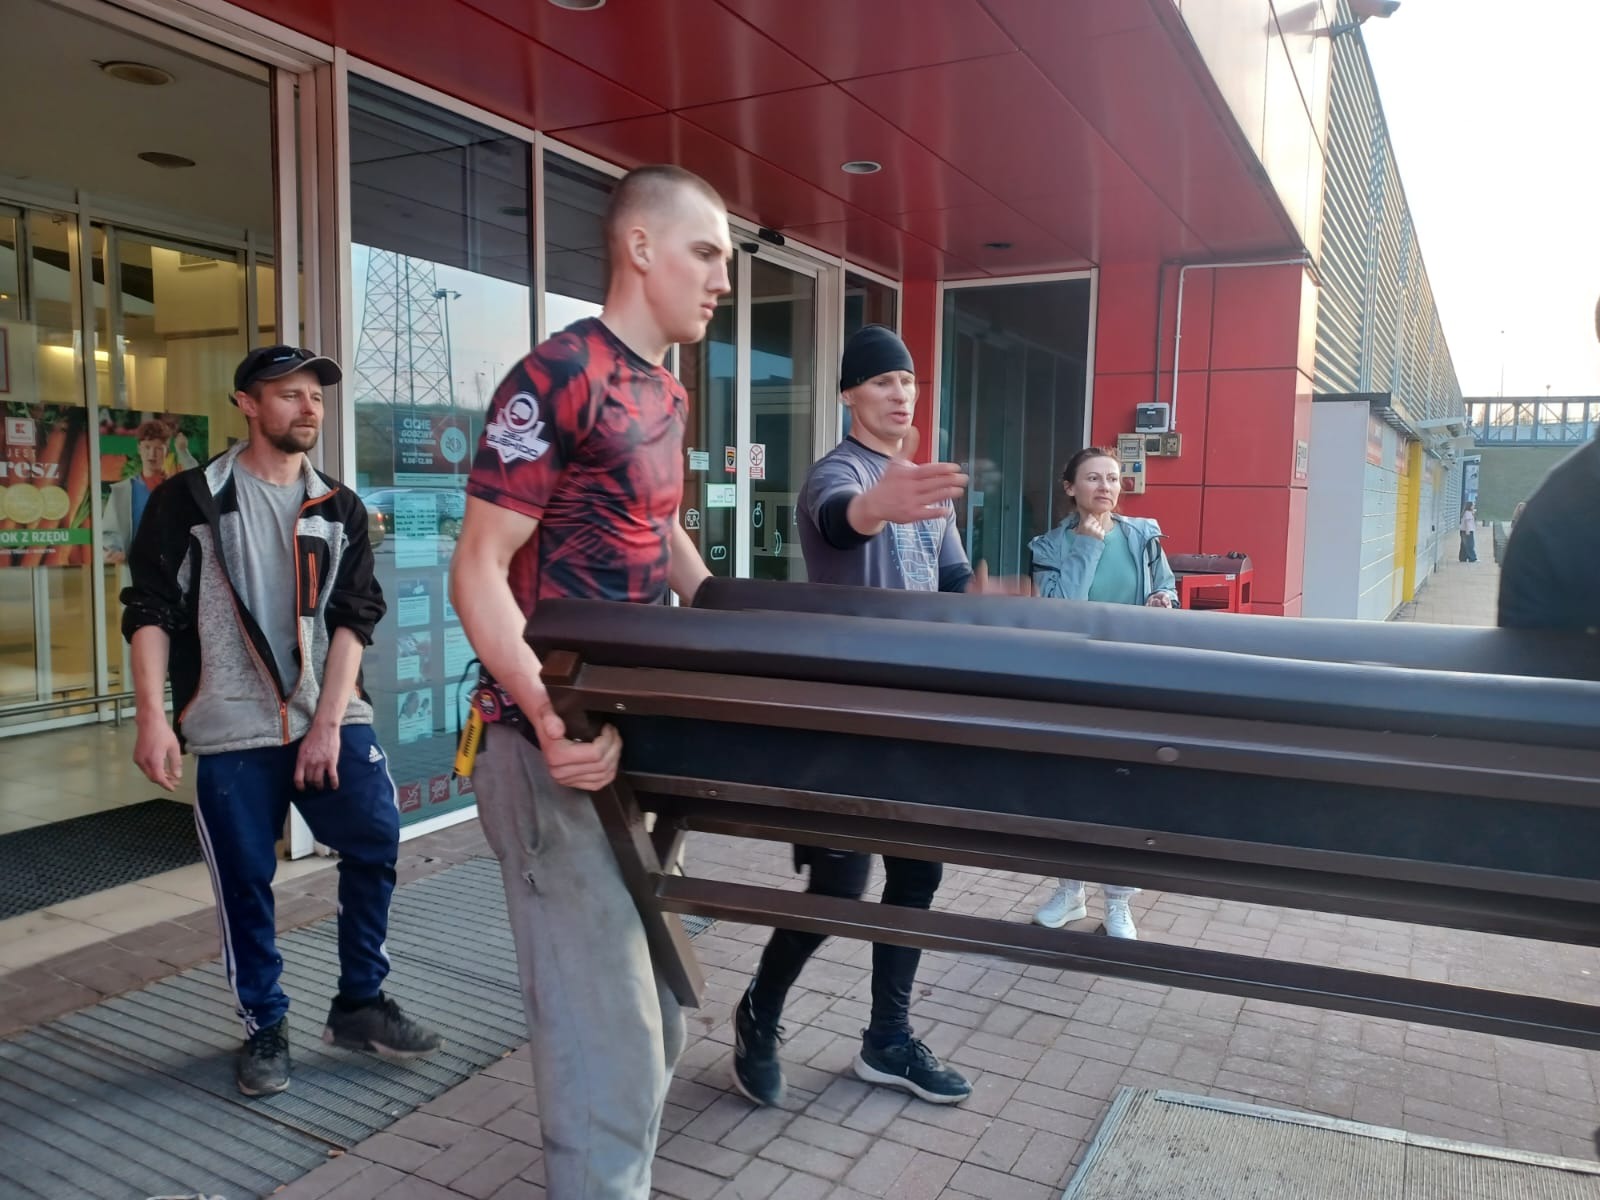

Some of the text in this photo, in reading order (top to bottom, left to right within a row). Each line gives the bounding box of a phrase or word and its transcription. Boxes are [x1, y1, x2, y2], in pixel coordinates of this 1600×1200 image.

[403, 417, 431, 430] CICHE
[7, 447, 37, 459] JEST
[21, 531, 30, 543] Z
[31, 530, 70, 545] RZĘDU
